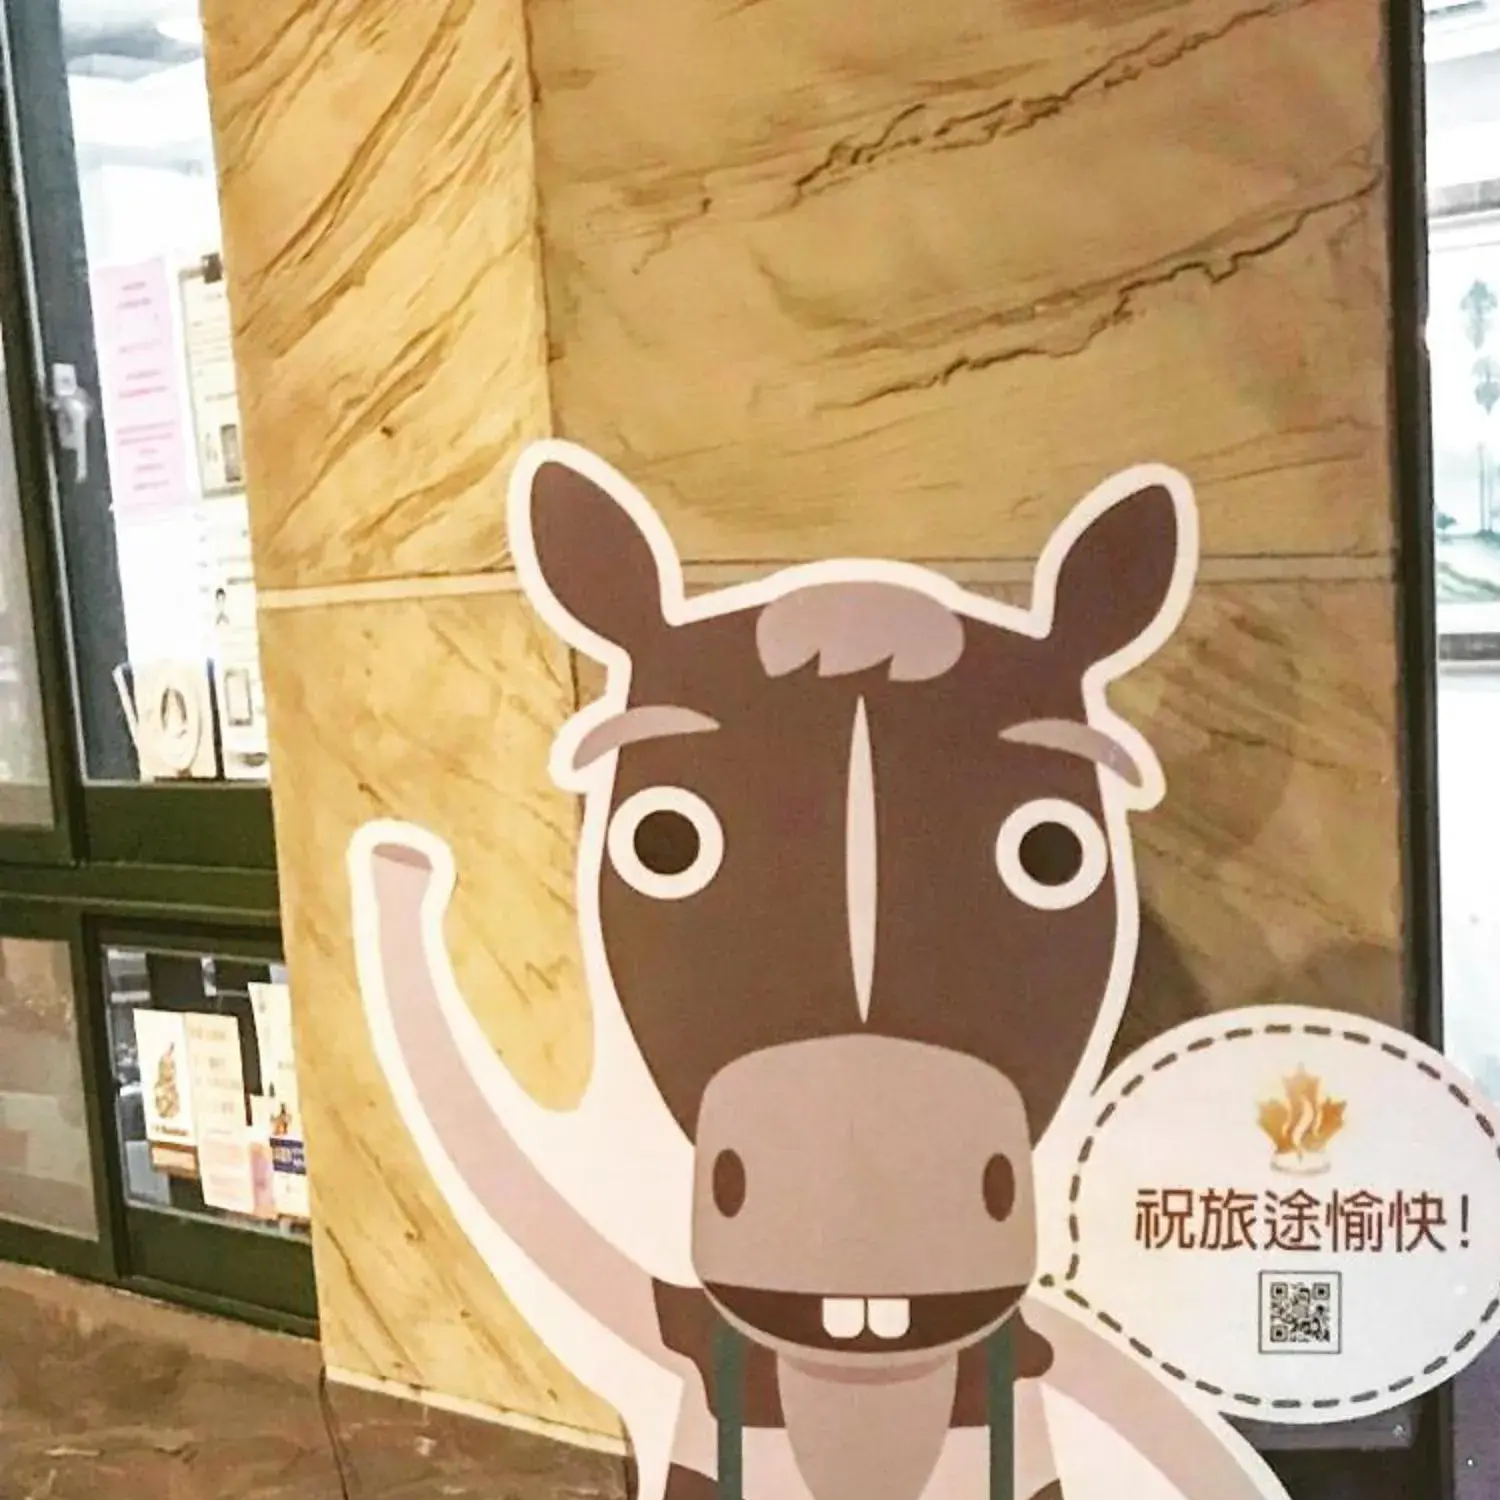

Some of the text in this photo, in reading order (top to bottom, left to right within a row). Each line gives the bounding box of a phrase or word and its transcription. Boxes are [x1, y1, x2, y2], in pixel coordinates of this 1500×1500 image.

[1135, 1188, 1469, 1252] 祝旅途愉快!
